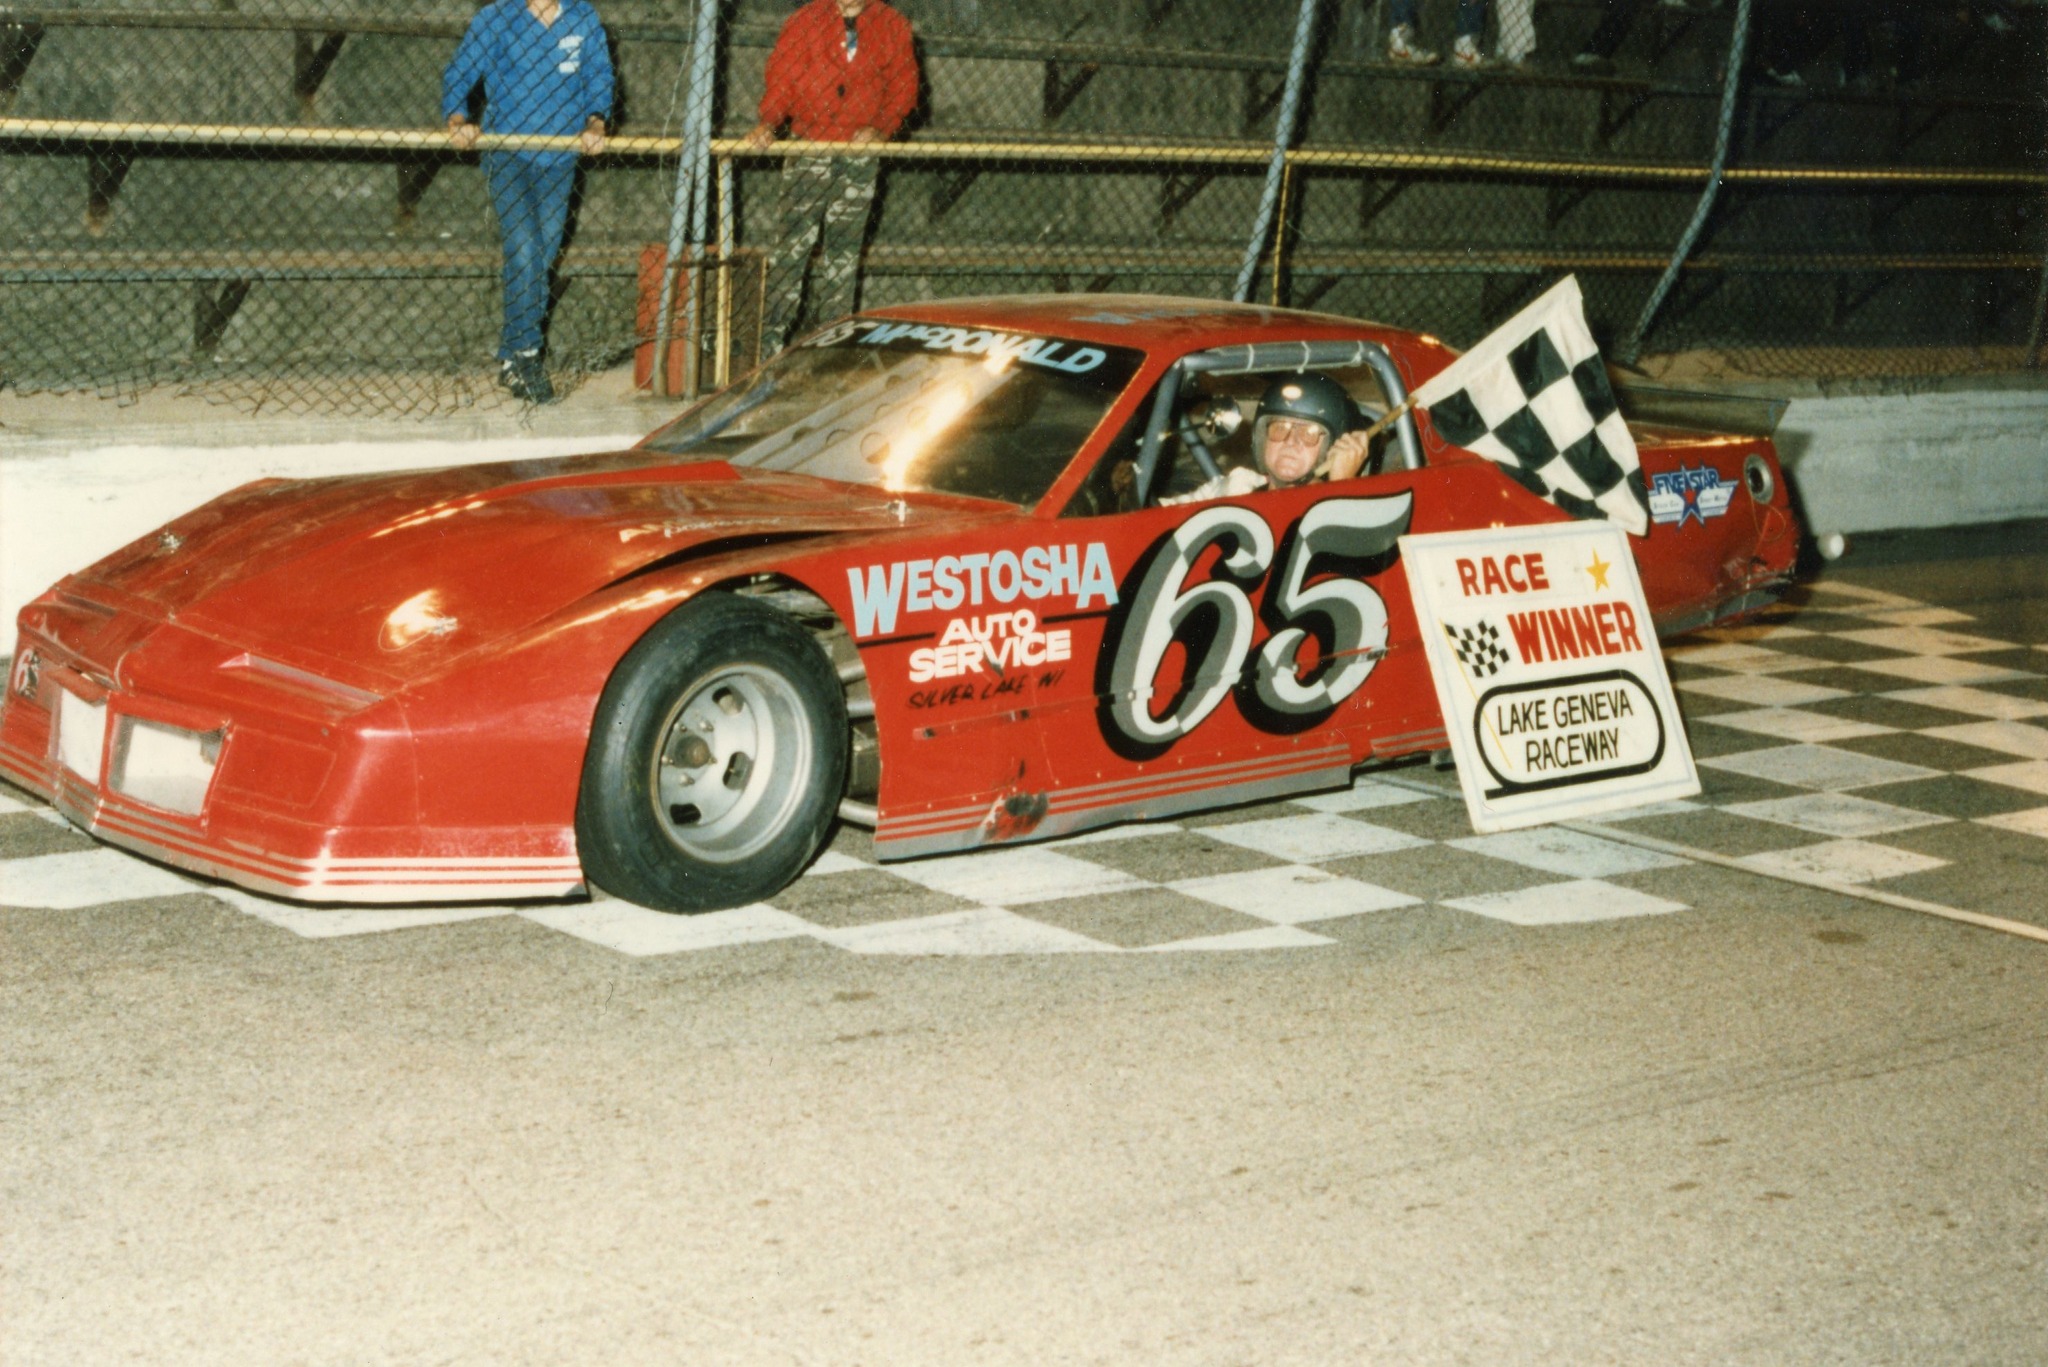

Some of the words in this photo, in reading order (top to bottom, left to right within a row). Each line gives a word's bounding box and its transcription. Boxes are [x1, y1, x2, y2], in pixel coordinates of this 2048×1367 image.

[1654, 472, 1684, 495] FIVE
[1689, 468, 1719, 490] STAR
[846, 542, 1119, 638] WESTOSHA
[1456, 553, 1550, 596] RACE
[939, 609, 1036, 646] AUTO
[1094, 487, 1413, 762] 65
[1507, 601, 1643, 665] WINNER
[908, 630, 1071, 683] SERVICE
[907, 684, 974, 709] SILVER
[981, 674, 1028, 700] LAKE
[1497, 700, 1549, 736] LAKE
[1553, 689, 1633, 728] GENEVA
[1525, 728, 1619, 772] RACEWAY
